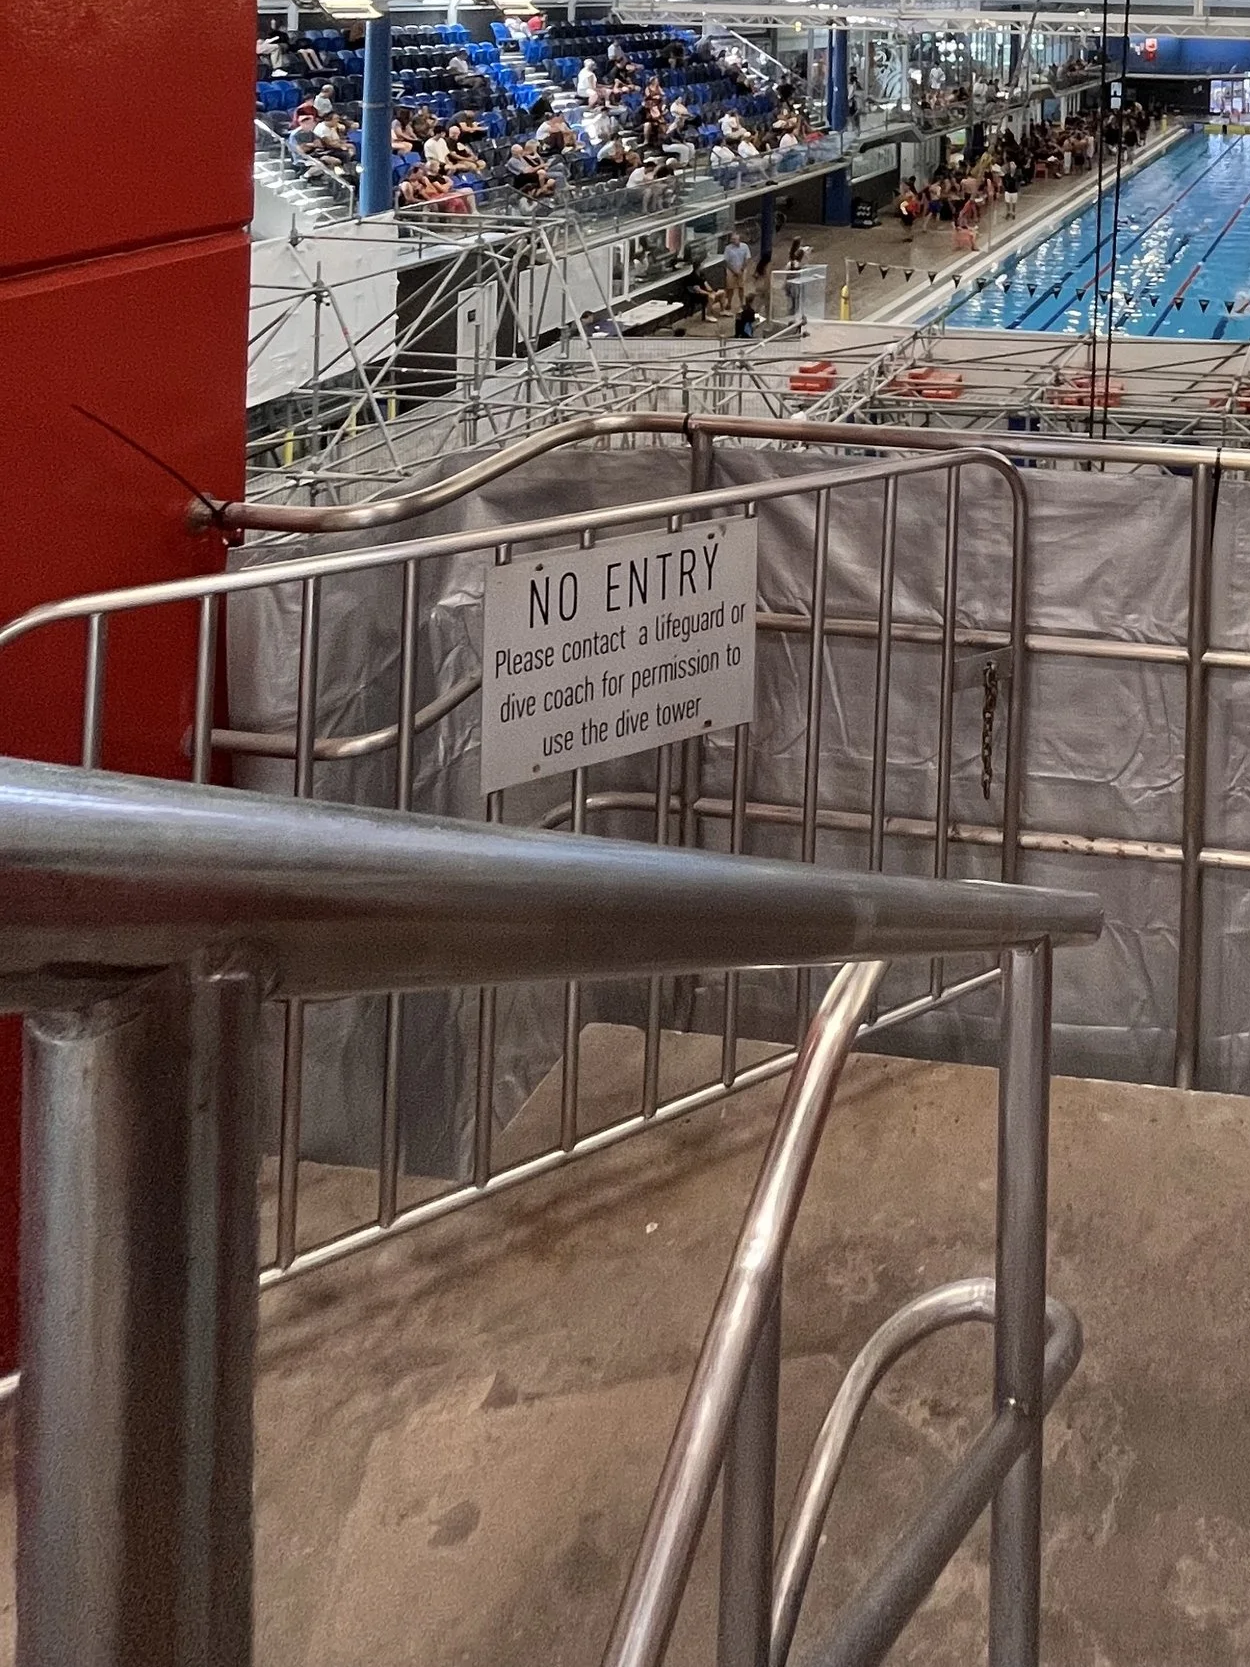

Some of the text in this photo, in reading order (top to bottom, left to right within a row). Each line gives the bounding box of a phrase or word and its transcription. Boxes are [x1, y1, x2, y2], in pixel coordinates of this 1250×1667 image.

[529, 543, 719, 628] NO ENTRY
[495, 601, 746, 678] Please contact a lifeguard or
[500, 643, 741, 723] dive coach for permission to
[542, 696, 702, 756] use the dive tower
